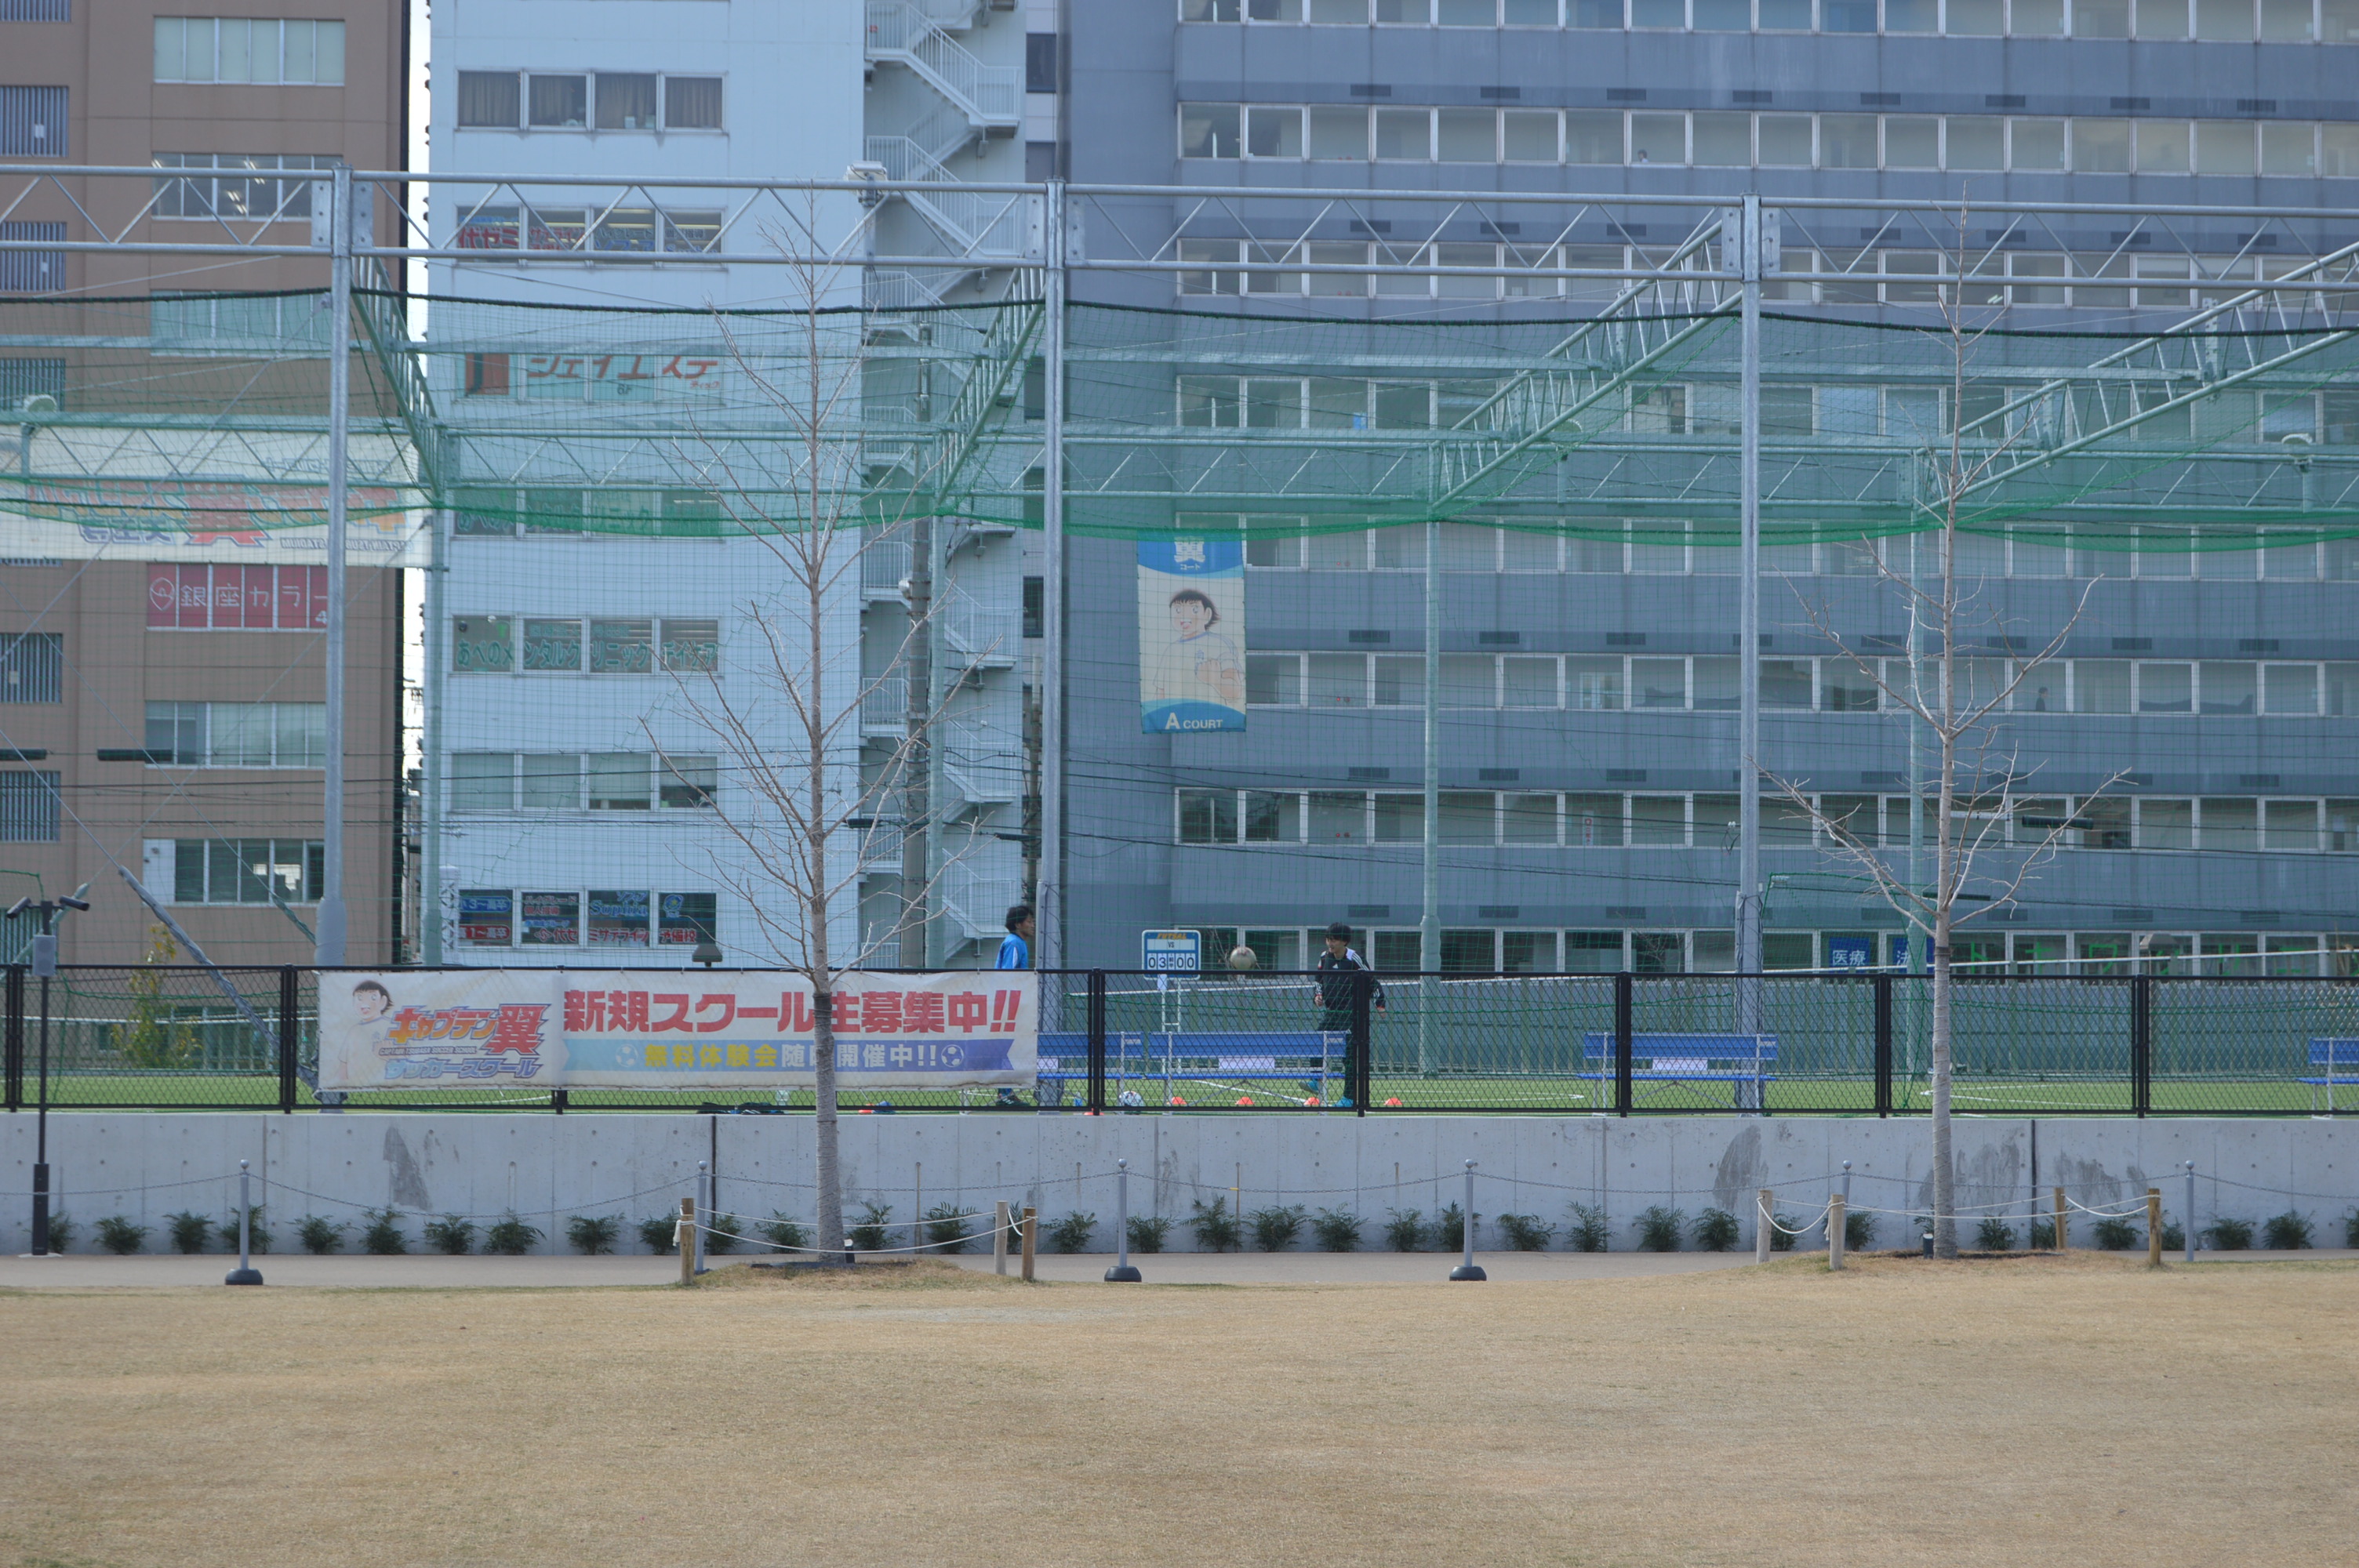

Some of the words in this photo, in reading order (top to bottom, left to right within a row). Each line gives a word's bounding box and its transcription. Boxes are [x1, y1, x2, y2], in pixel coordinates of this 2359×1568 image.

[457, 640, 650, 667] あべのメンタルクリニック
[1165, 712, 1180, 730] A
[1183, 719, 1223, 729] COURT
[589, 899, 648, 917] Sophia
[1832, 949, 1866, 966] 医療
[563, 989, 1021, 1033] 新規スクール生募集中!!
[384, 1004, 553, 1056] キャプテン翼
[379, 1047, 405, 1056] CAPTAIN
[405, 1047, 431, 1055] TSUBASA
[453, 1046, 477, 1054] SCHOOL
[384, 1058, 544, 1080] サッカースクール
